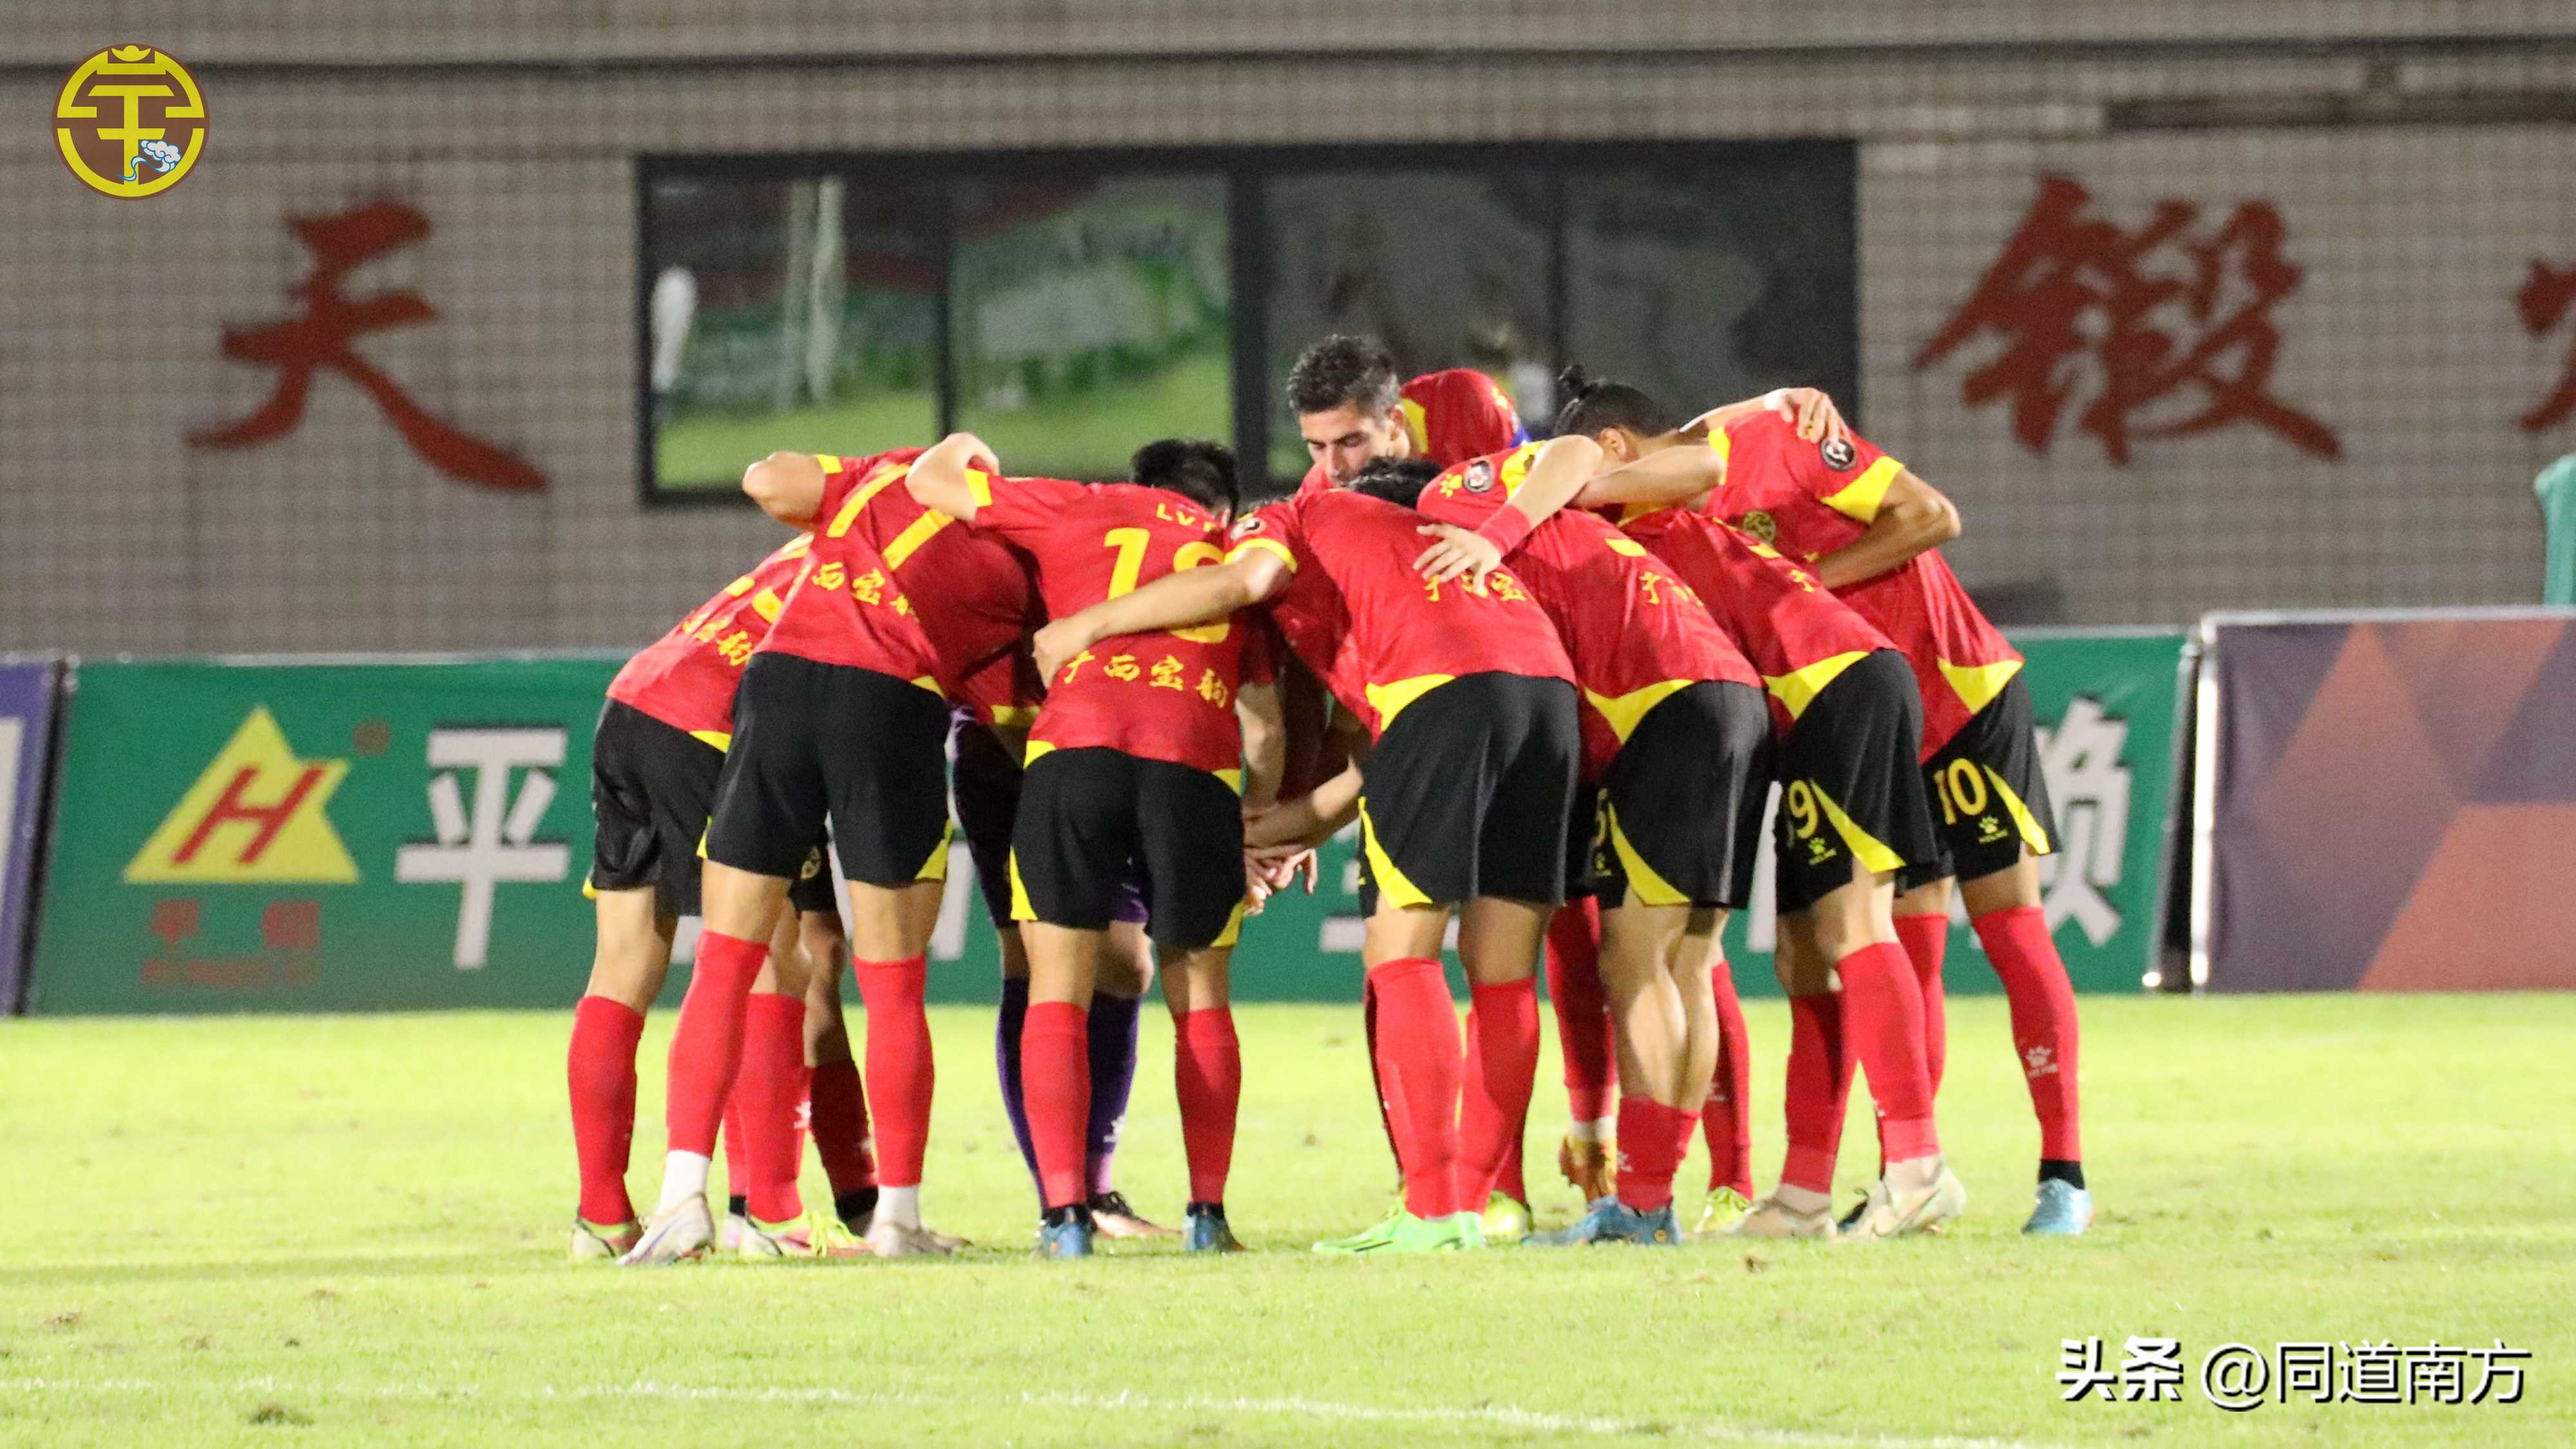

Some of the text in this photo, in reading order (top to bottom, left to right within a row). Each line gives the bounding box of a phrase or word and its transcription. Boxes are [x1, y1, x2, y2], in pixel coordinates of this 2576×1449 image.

[184, 198, 549, 493] 天
[170, 766, 330, 867] H
[393, 725, 570, 971] 平
[1934, 757, 1988, 826] 10
